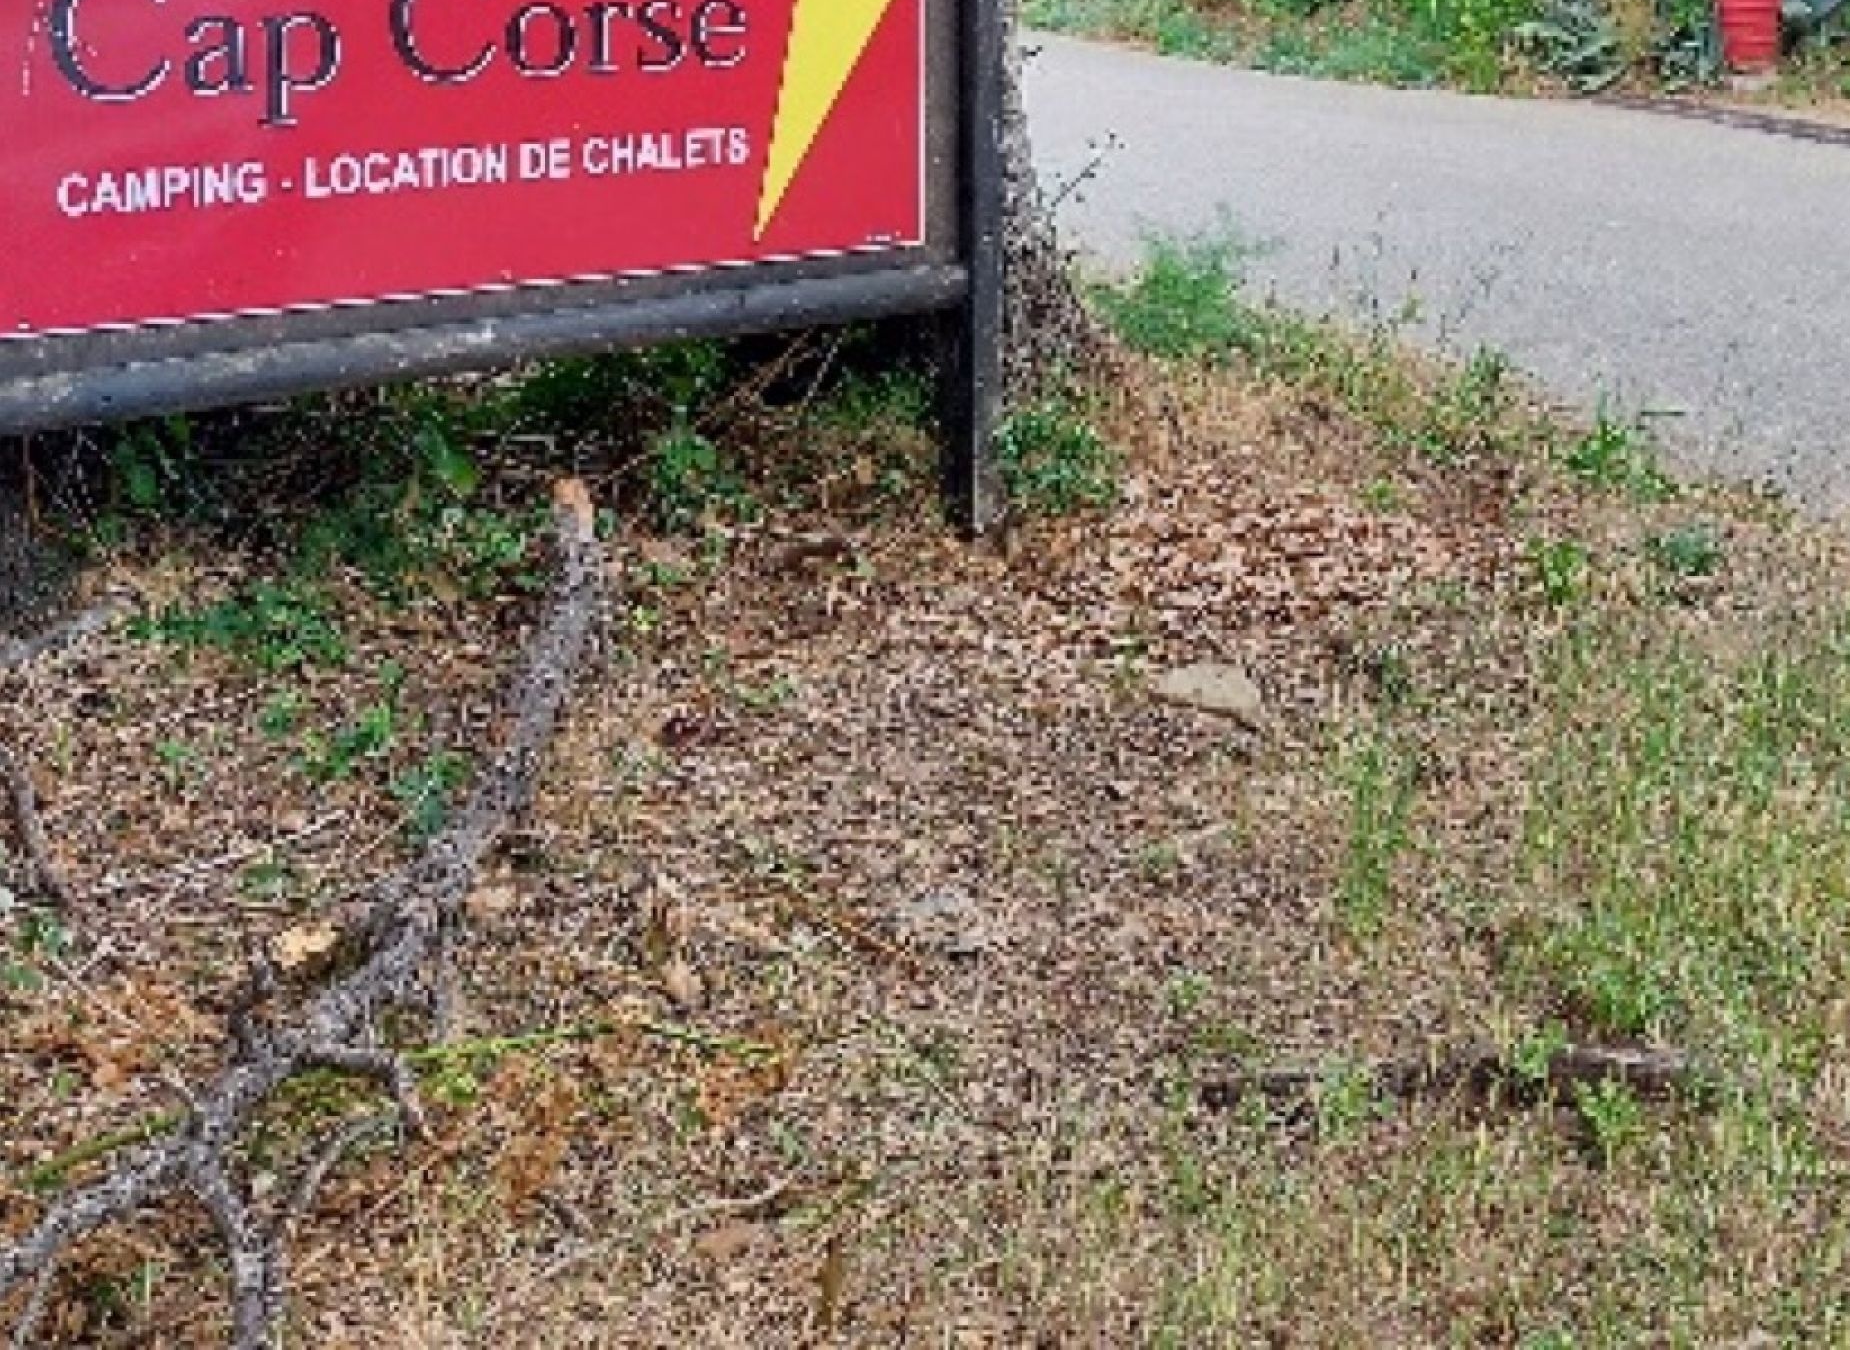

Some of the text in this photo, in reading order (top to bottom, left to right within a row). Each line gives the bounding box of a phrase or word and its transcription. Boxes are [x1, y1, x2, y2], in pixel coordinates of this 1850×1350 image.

[57, 163, 268, 217] CAMPING
[304, 147, 508, 199] LOCATION
[519, 140, 571, 180] DE
[582, 127, 750, 174] CHALETS
